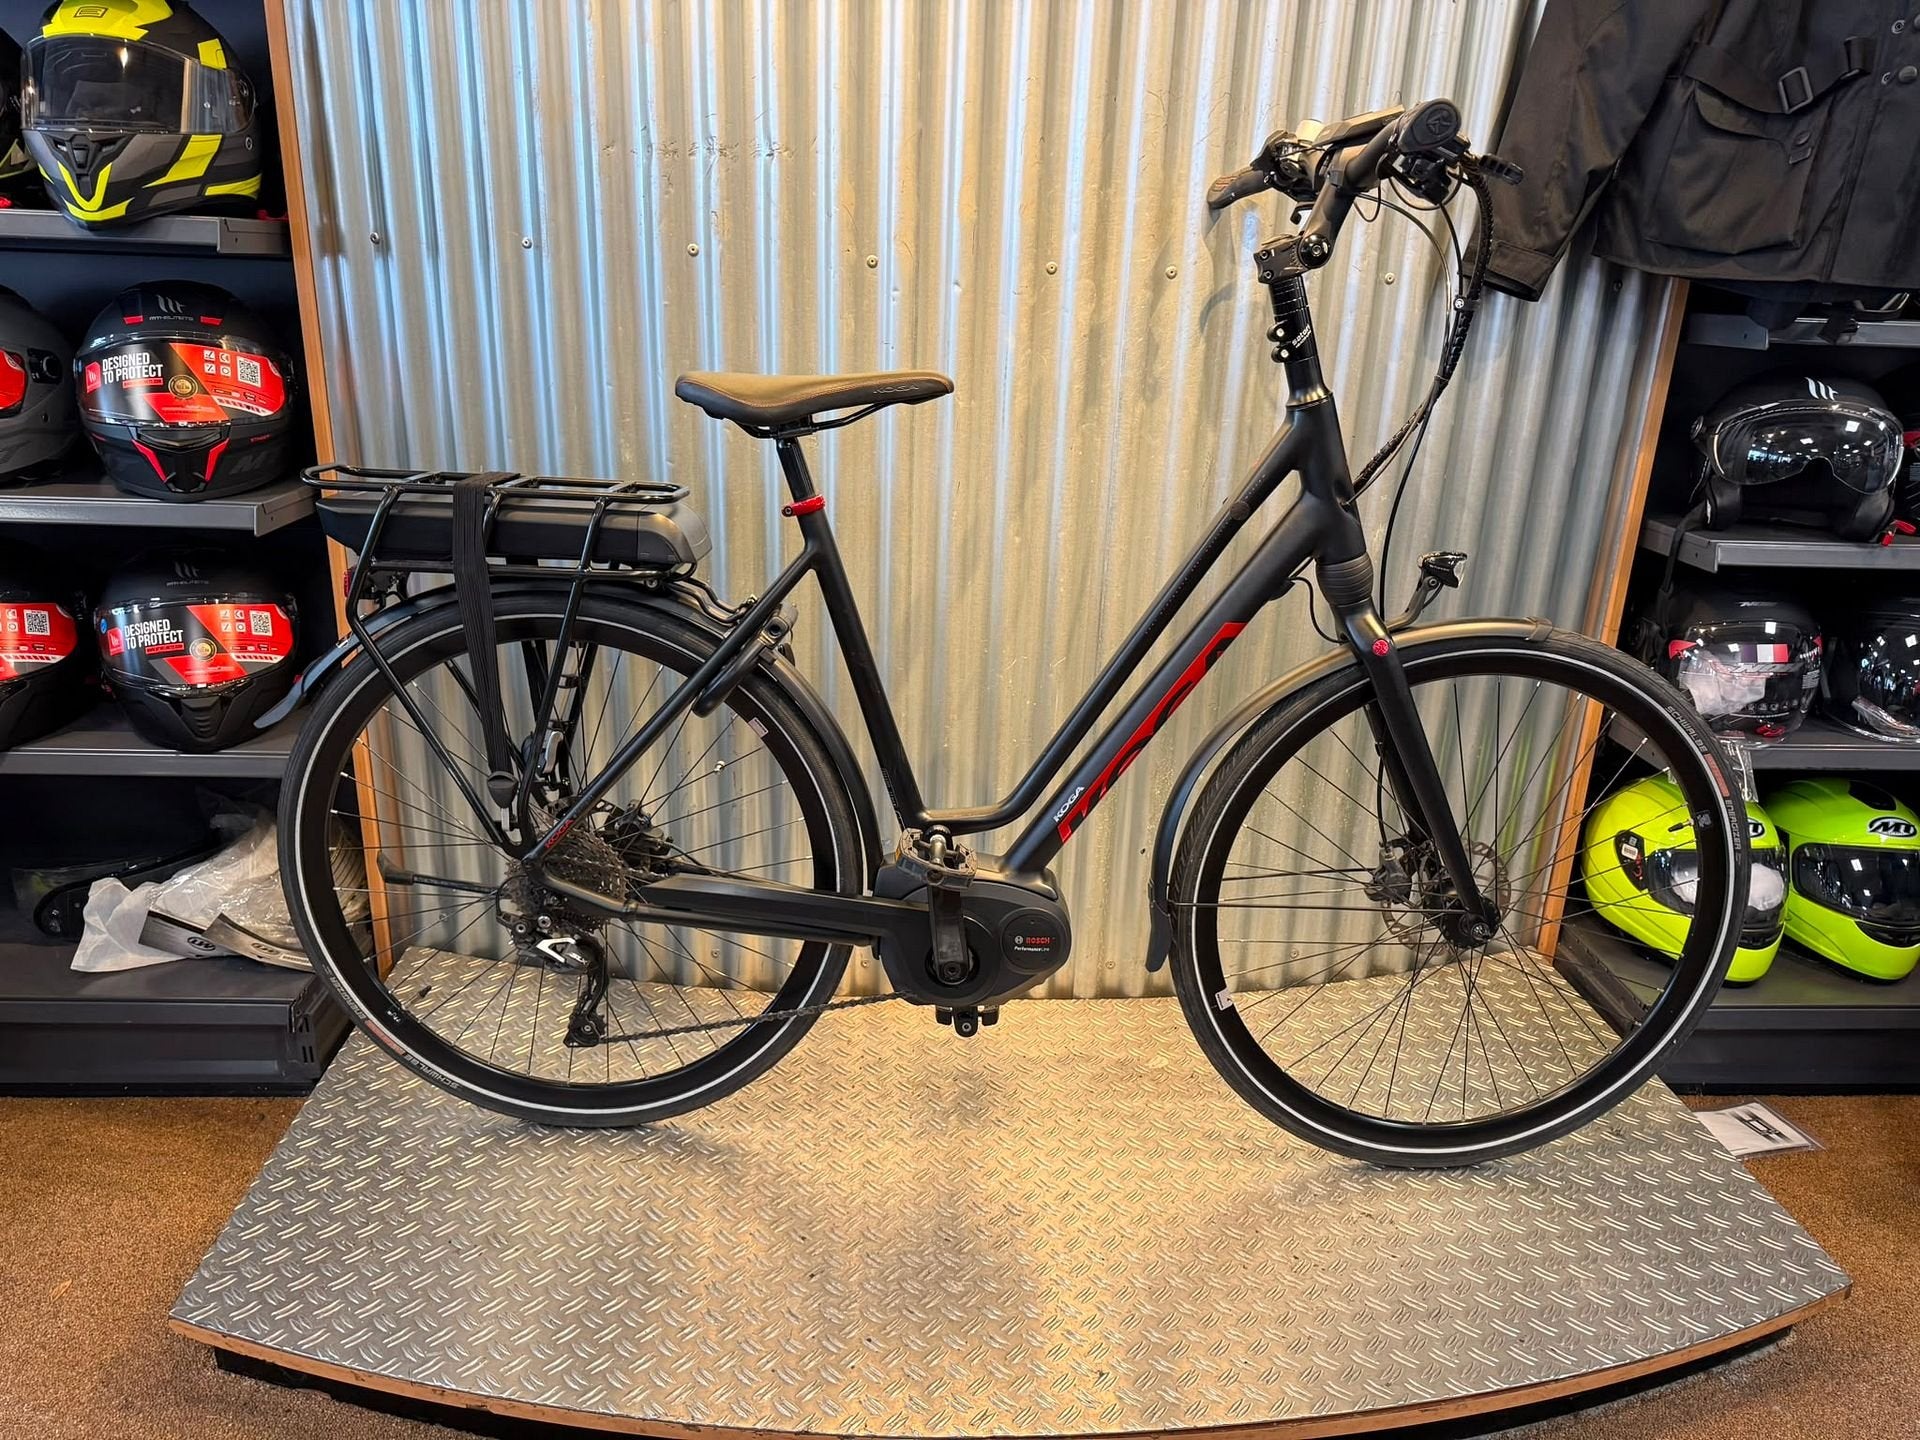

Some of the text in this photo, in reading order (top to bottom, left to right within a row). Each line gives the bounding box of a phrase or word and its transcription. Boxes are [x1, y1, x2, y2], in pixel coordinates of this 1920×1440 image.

[102, 352, 150, 372] DESIGNED
[103, 370, 114, 385] TO
[116, 364, 163, 382] PROTECT
[124, 619, 171, 638] DESIGNED
[126, 637, 137, 650] TO
[138, 629, 183, 648] PROTECT
[1665, 705, 1708, 752] SCHWALBE
[1053, 786, 1085, 822] KOGA
[1725, 799, 1742, 850] ENERGIZER
[1025, 937, 1051, 945] BOSCH
[404, 1054, 460, 1090] SCHWALBE
